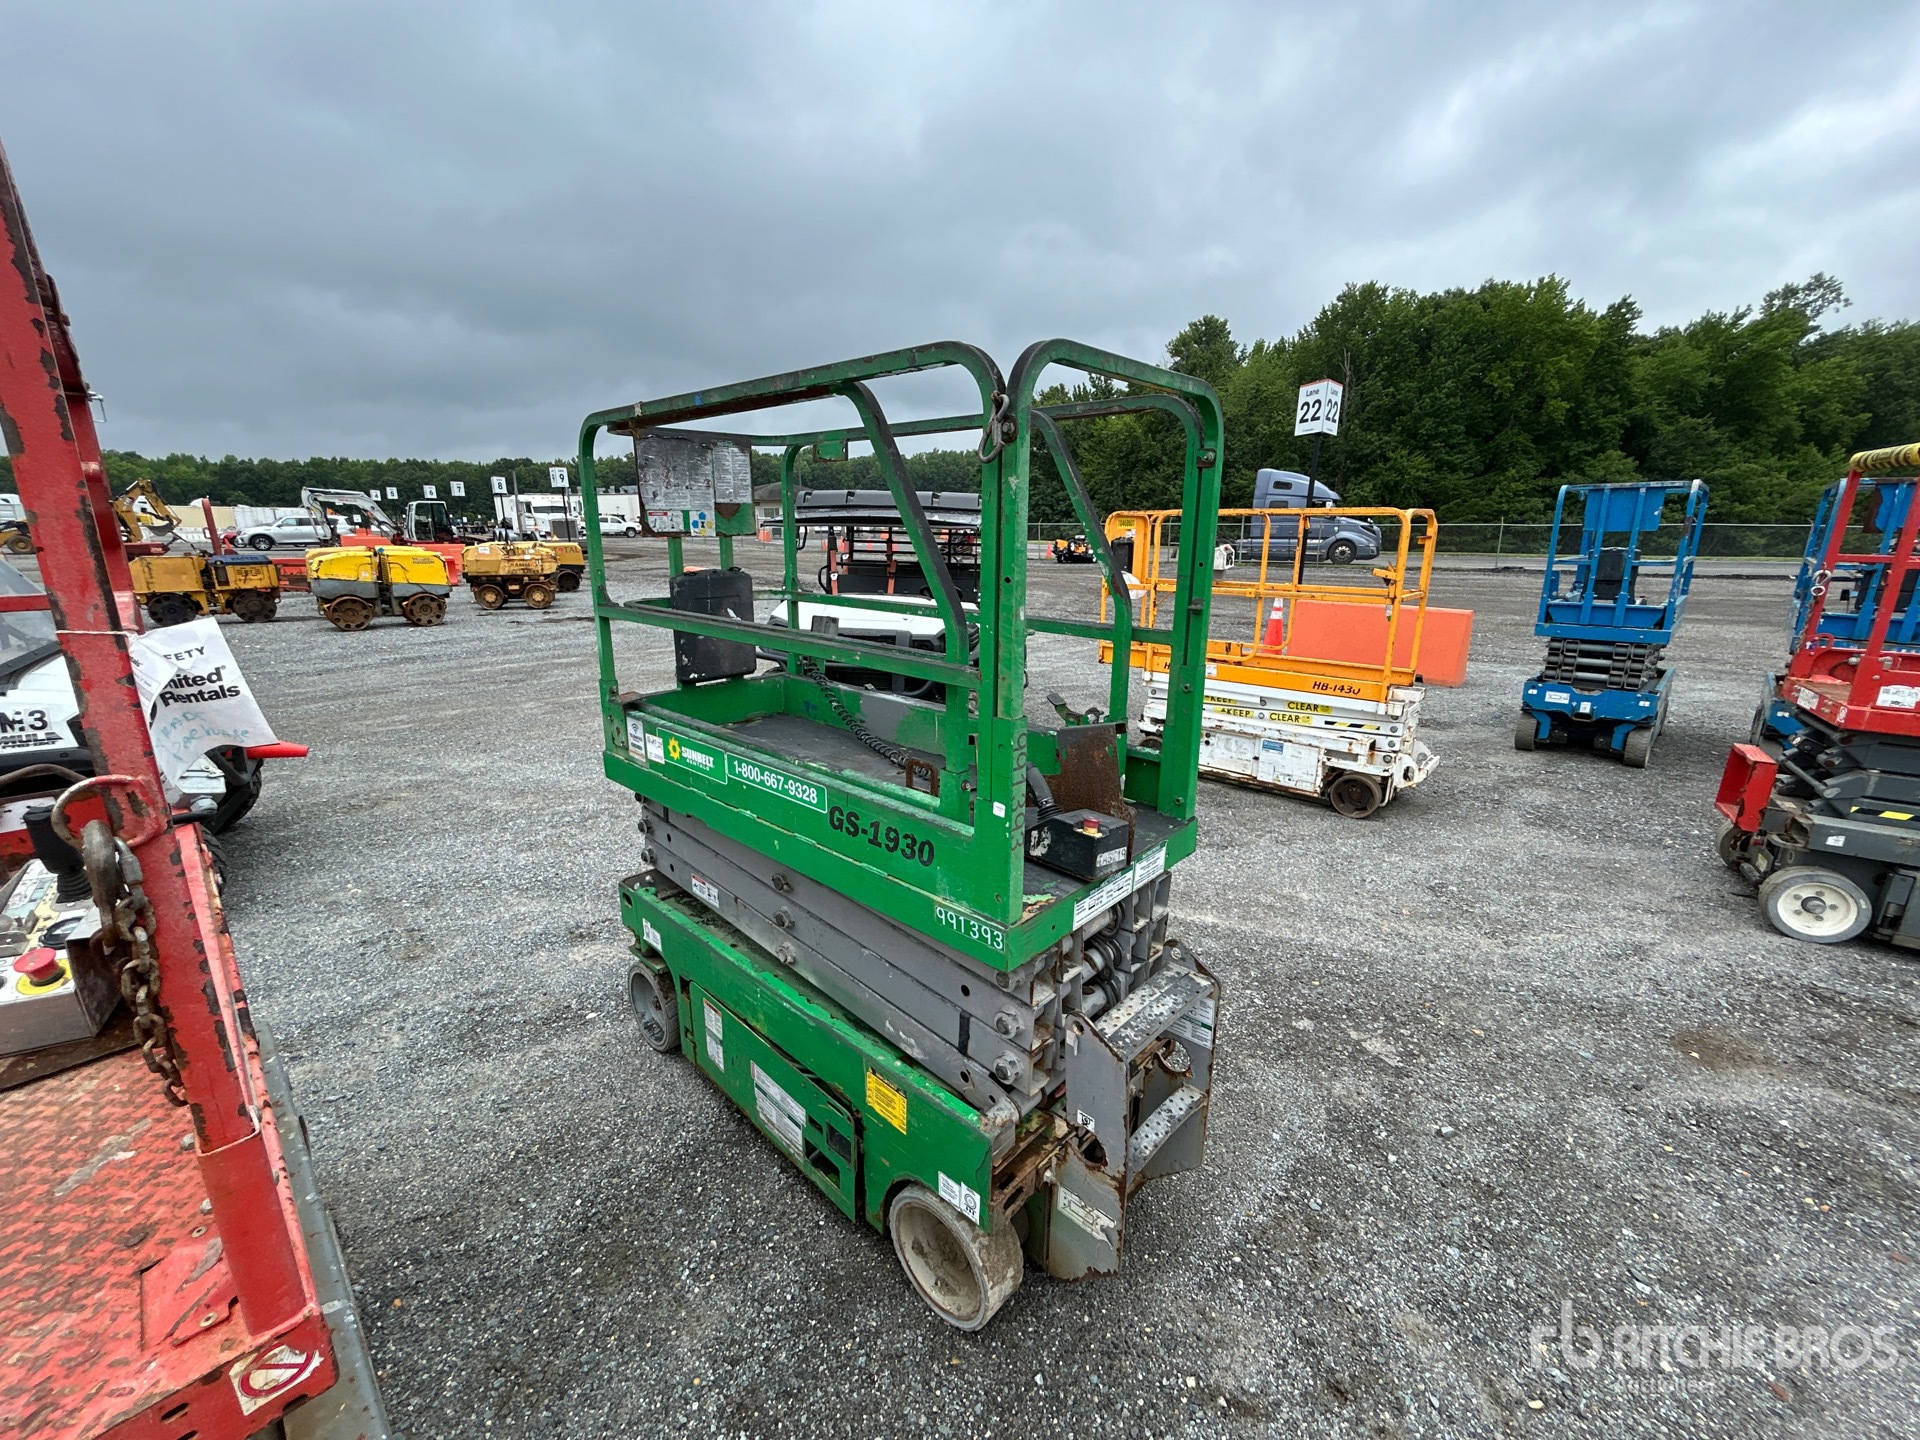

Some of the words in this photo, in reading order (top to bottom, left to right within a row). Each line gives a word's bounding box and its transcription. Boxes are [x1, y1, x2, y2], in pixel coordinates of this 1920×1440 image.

[1306, 389, 1320, 397] Lane
[1299, 399, 1322, 424] 22
[1325, 399, 1338, 424] 22
[498, 482, 503, 490] 8
[559, 473, 565, 483] 9
[163, 646, 205, 661] FETY
[163, 665, 224, 691] nited
[160, 684, 241, 707] Rentals
[1287, 701, 1319, 712] CLEAR
[1227, 708, 1251, 717] KEEP
[1269, 712, 1300, 723] CLEAR
[681, 746, 714, 768] SUNBELT
[686, 758, 710, 771] RENTALS
[733, 760, 818, 804] 1-800-667-9328
[1011, 732, 1028, 851] 991393
[828, 805, 935, 867] GS-1930
[936, 907, 1004, 950] 991393
